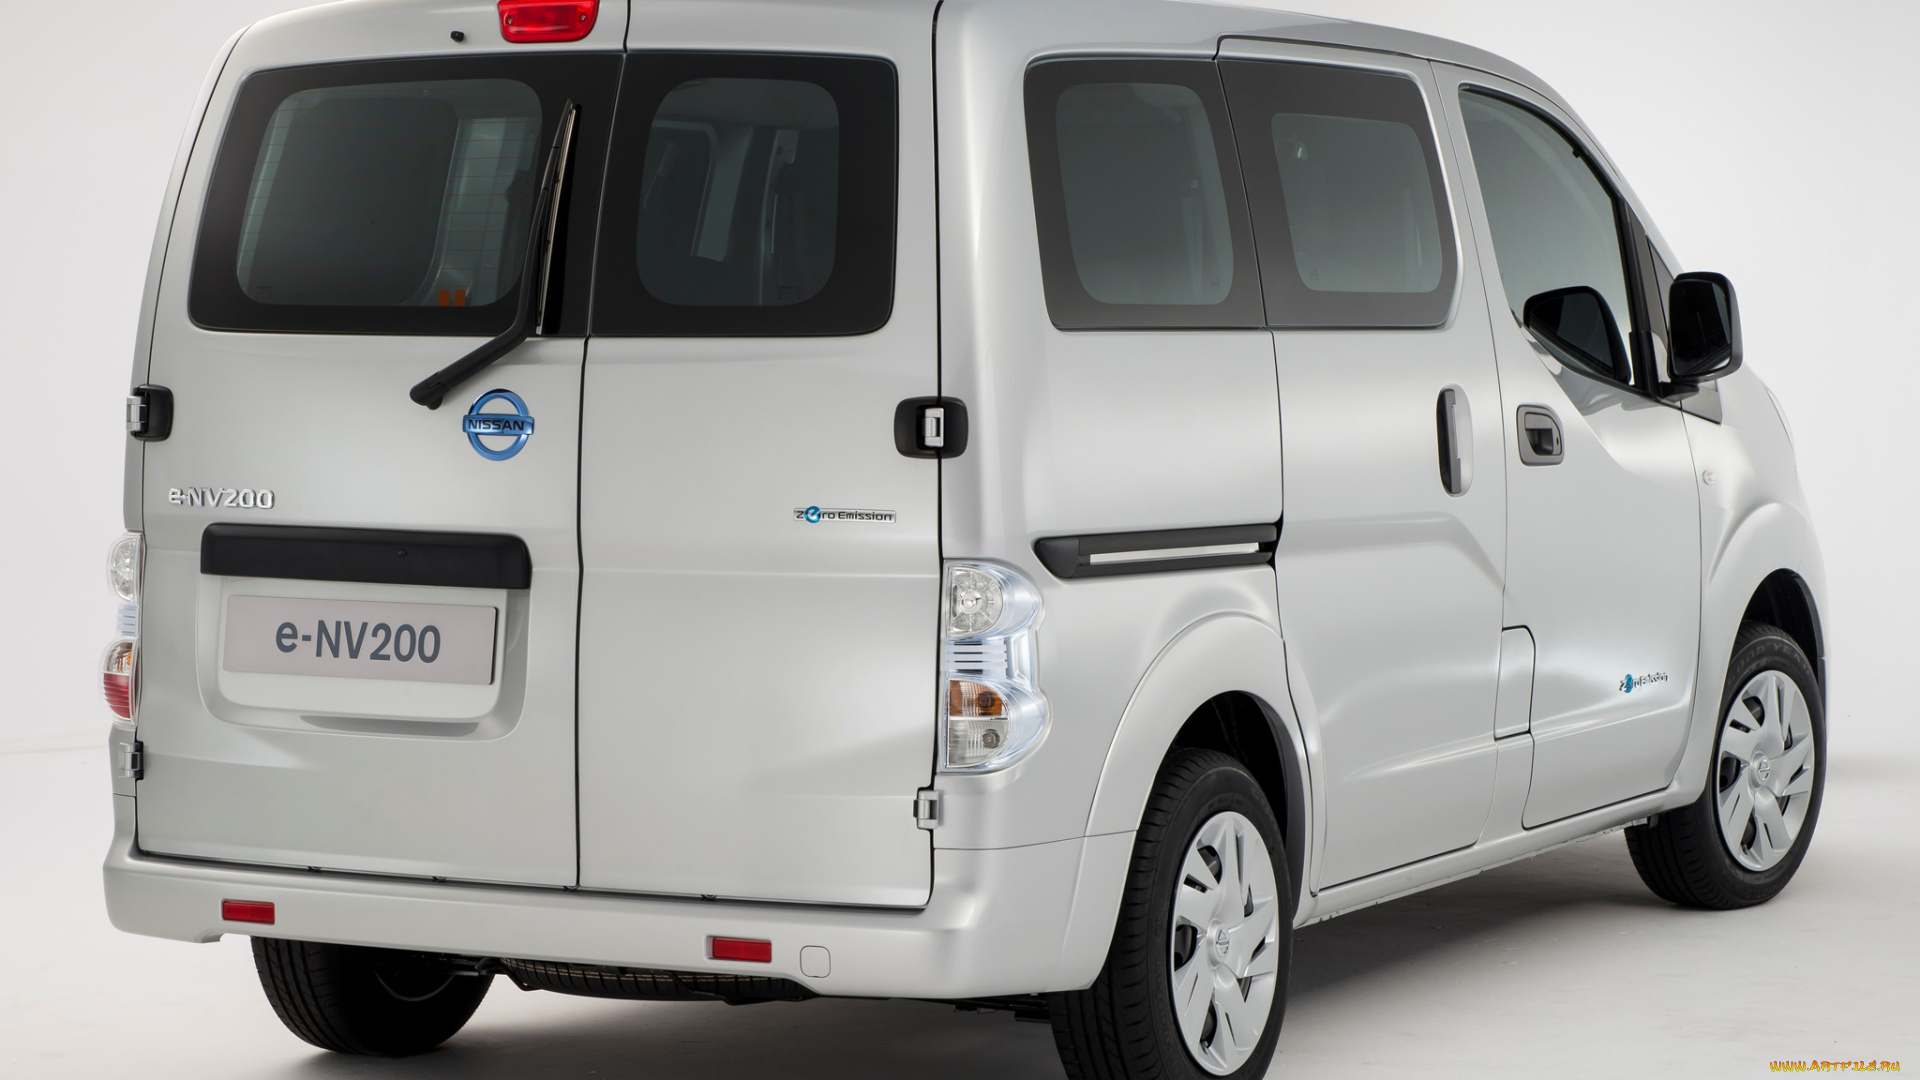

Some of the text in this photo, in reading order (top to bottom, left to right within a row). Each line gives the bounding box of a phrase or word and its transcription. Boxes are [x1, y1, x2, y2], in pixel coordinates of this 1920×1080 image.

[468, 419, 524, 431] NISSAN
[168, 487, 275, 509] e-NV200
[838, 510, 893, 521] Emission
[275, 619, 441, 664] e-NV200
